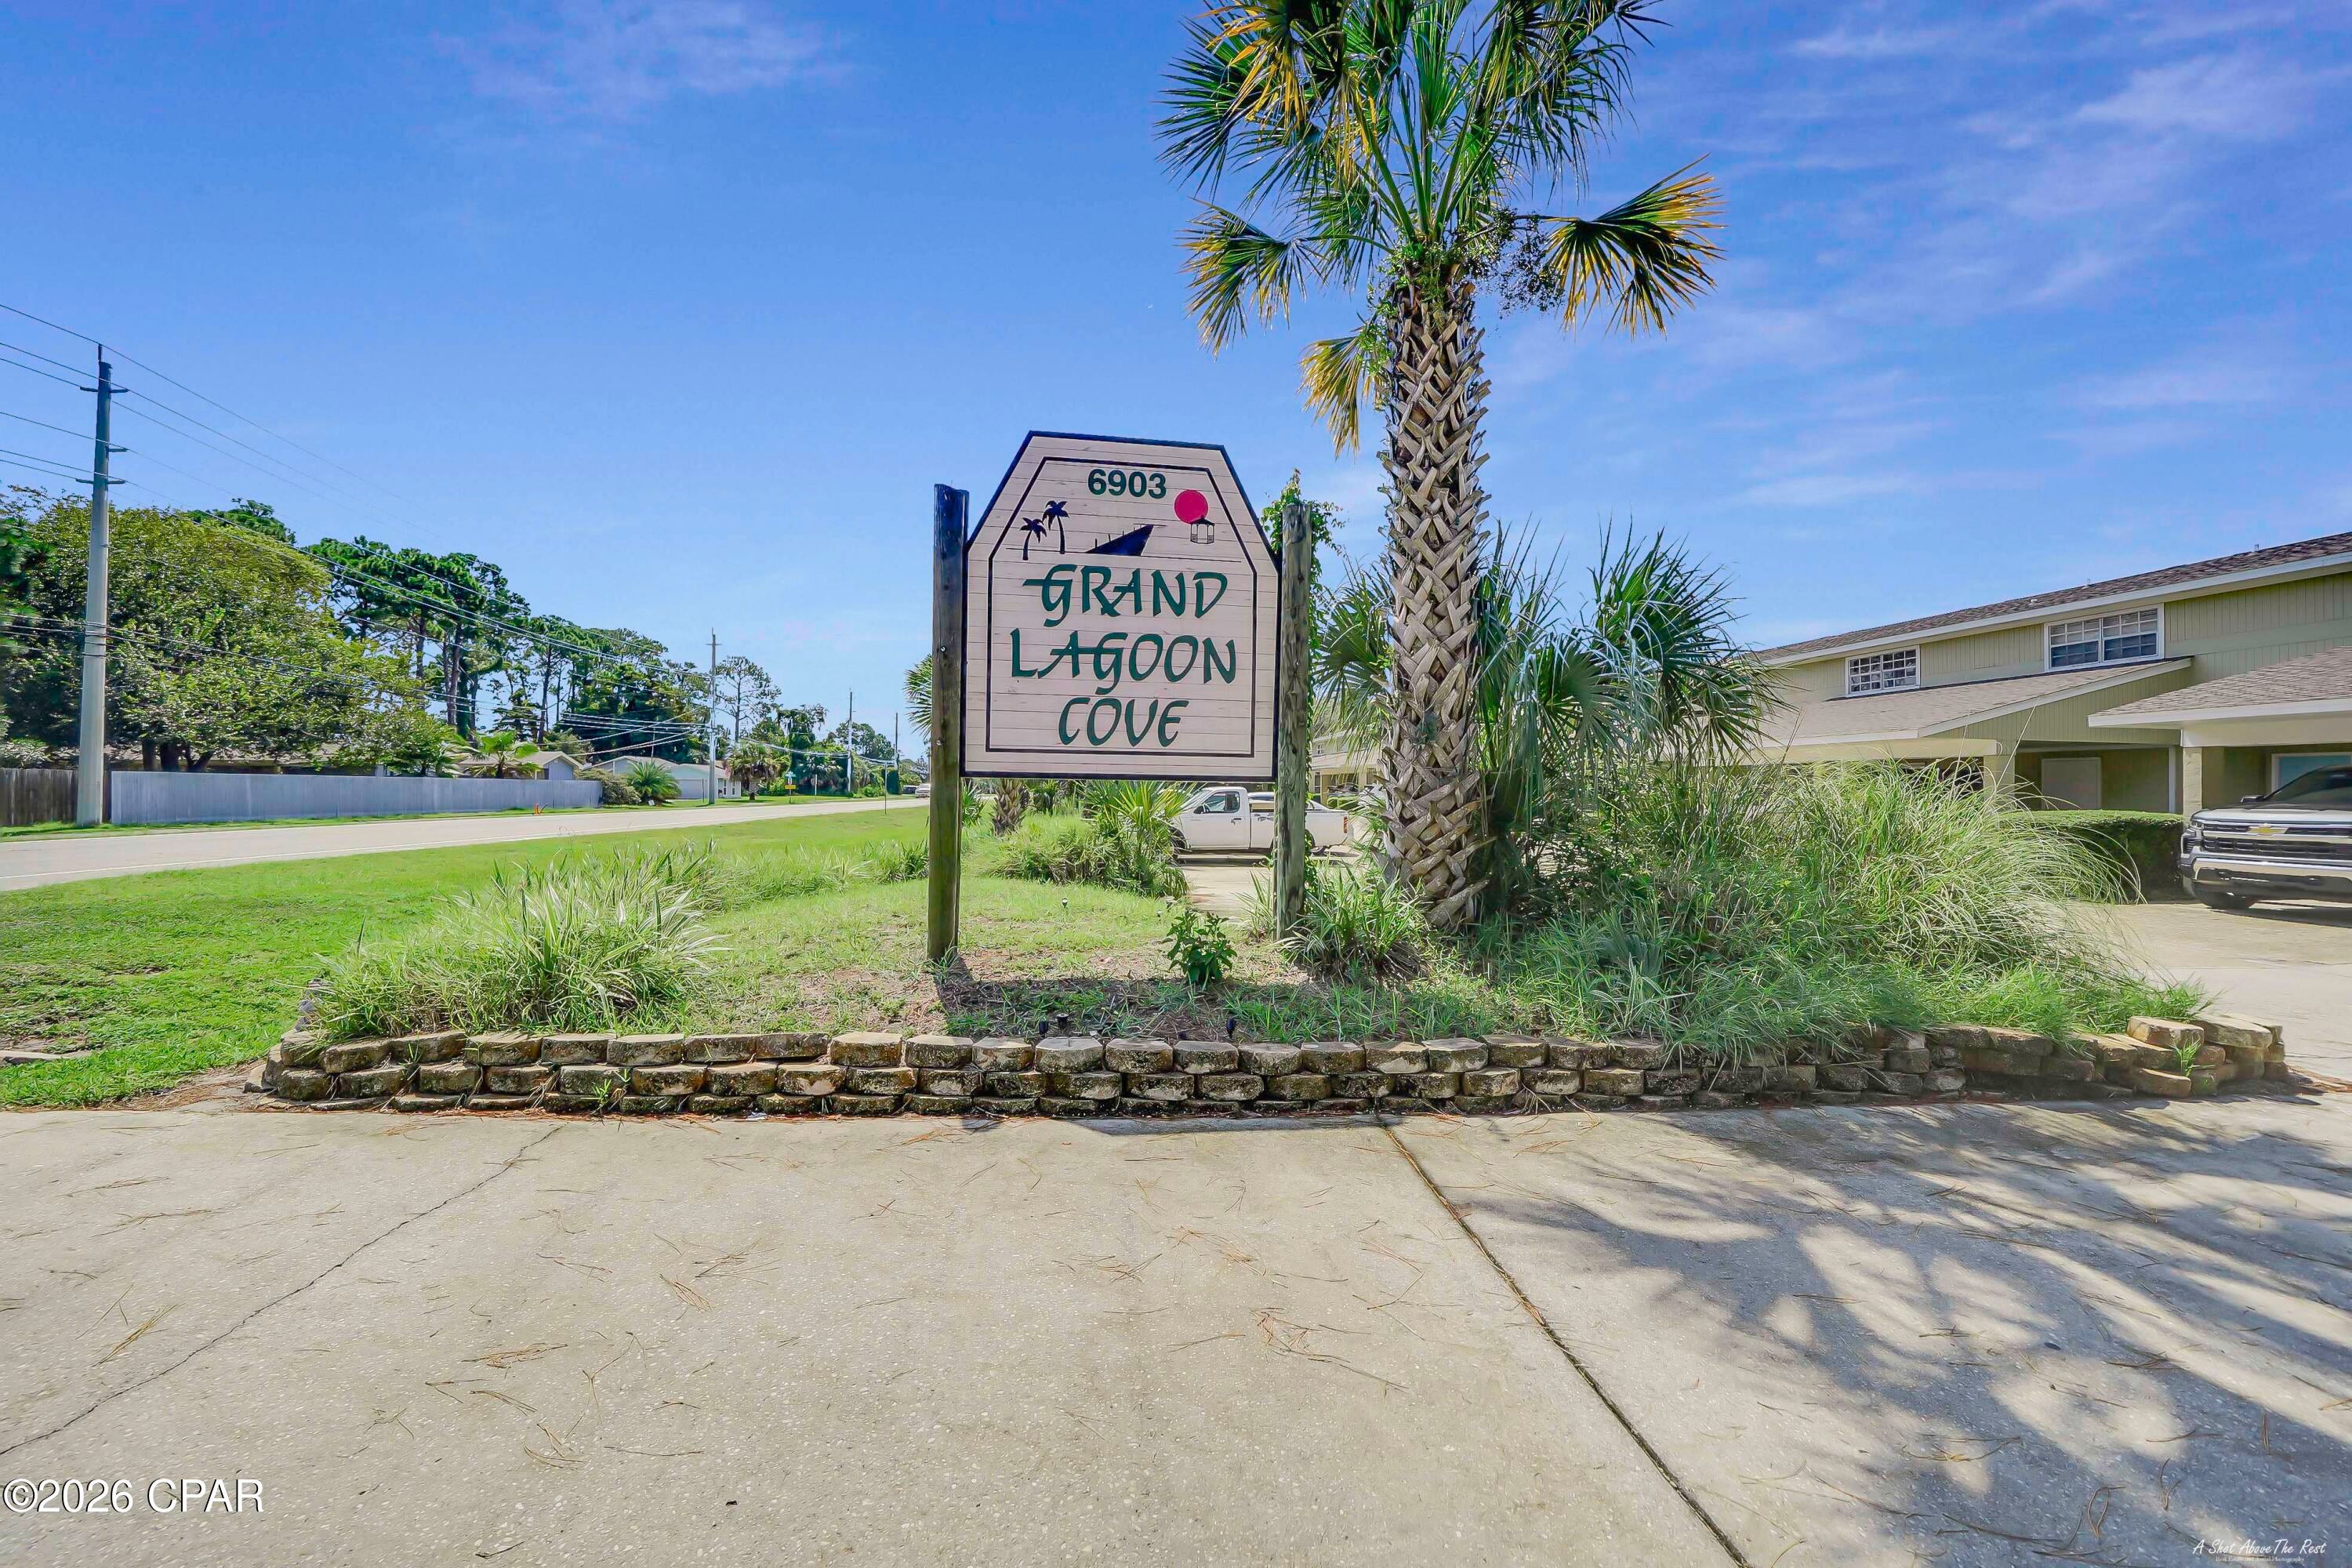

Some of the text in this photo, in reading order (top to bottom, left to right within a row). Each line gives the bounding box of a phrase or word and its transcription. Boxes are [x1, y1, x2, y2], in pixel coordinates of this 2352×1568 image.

[1088, 469, 1167, 499] 6903
[1022, 564, 1229, 627] GRAND
[1010, 628, 1236, 695] LAGOON
[1058, 697, 1189, 747] COVE
